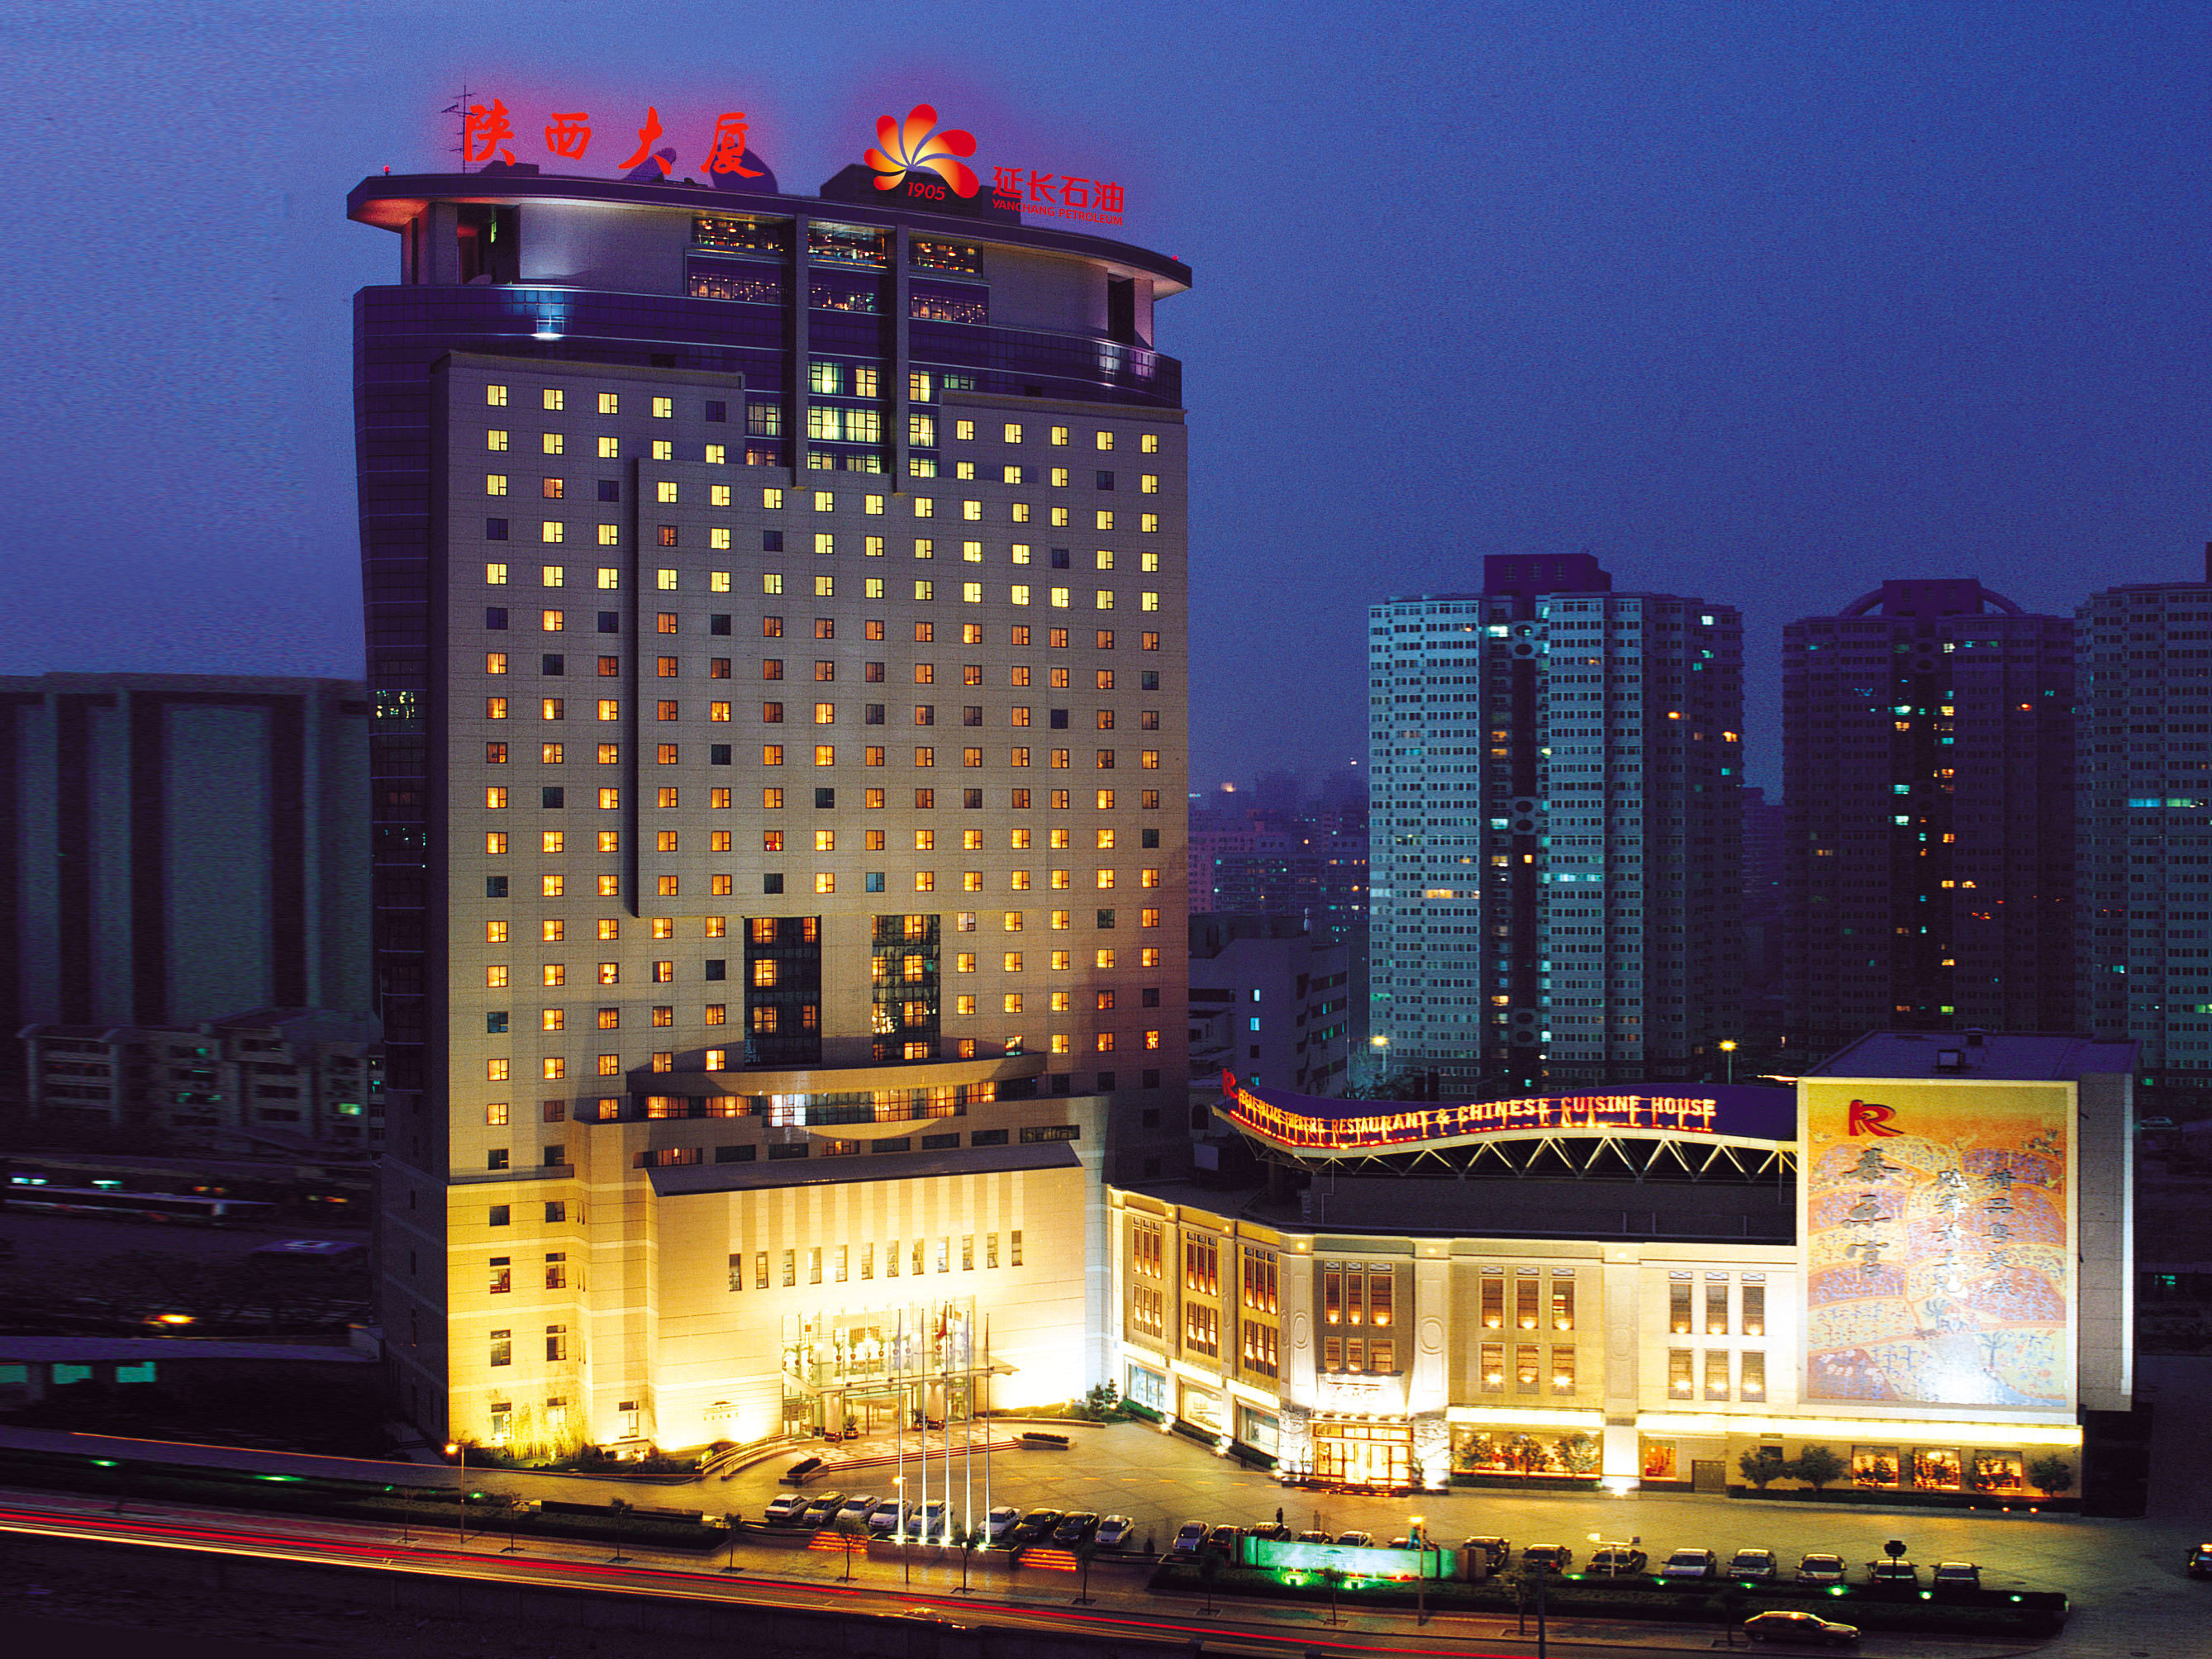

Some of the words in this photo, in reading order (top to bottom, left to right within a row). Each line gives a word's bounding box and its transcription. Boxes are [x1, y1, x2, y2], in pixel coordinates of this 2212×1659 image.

[463, 98, 765, 178] 陕西大厦
[907, 182, 946, 202] 1905
[992, 166, 1124, 213] 延长石油
[992, 198, 1056, 217] YANCHANG
[1058, 208, 1123, 226] PETROLEUM
[1332, 1110, 1429, 1134] RESTAURANT
[1435, 1108, 1450, 1124] &
[1458, 1098, 1551, 1123] CHINESE
[1561, 1096, 1642, 1114] CUISINE
[1652, 1097, 1717, 1117] HOUSE
